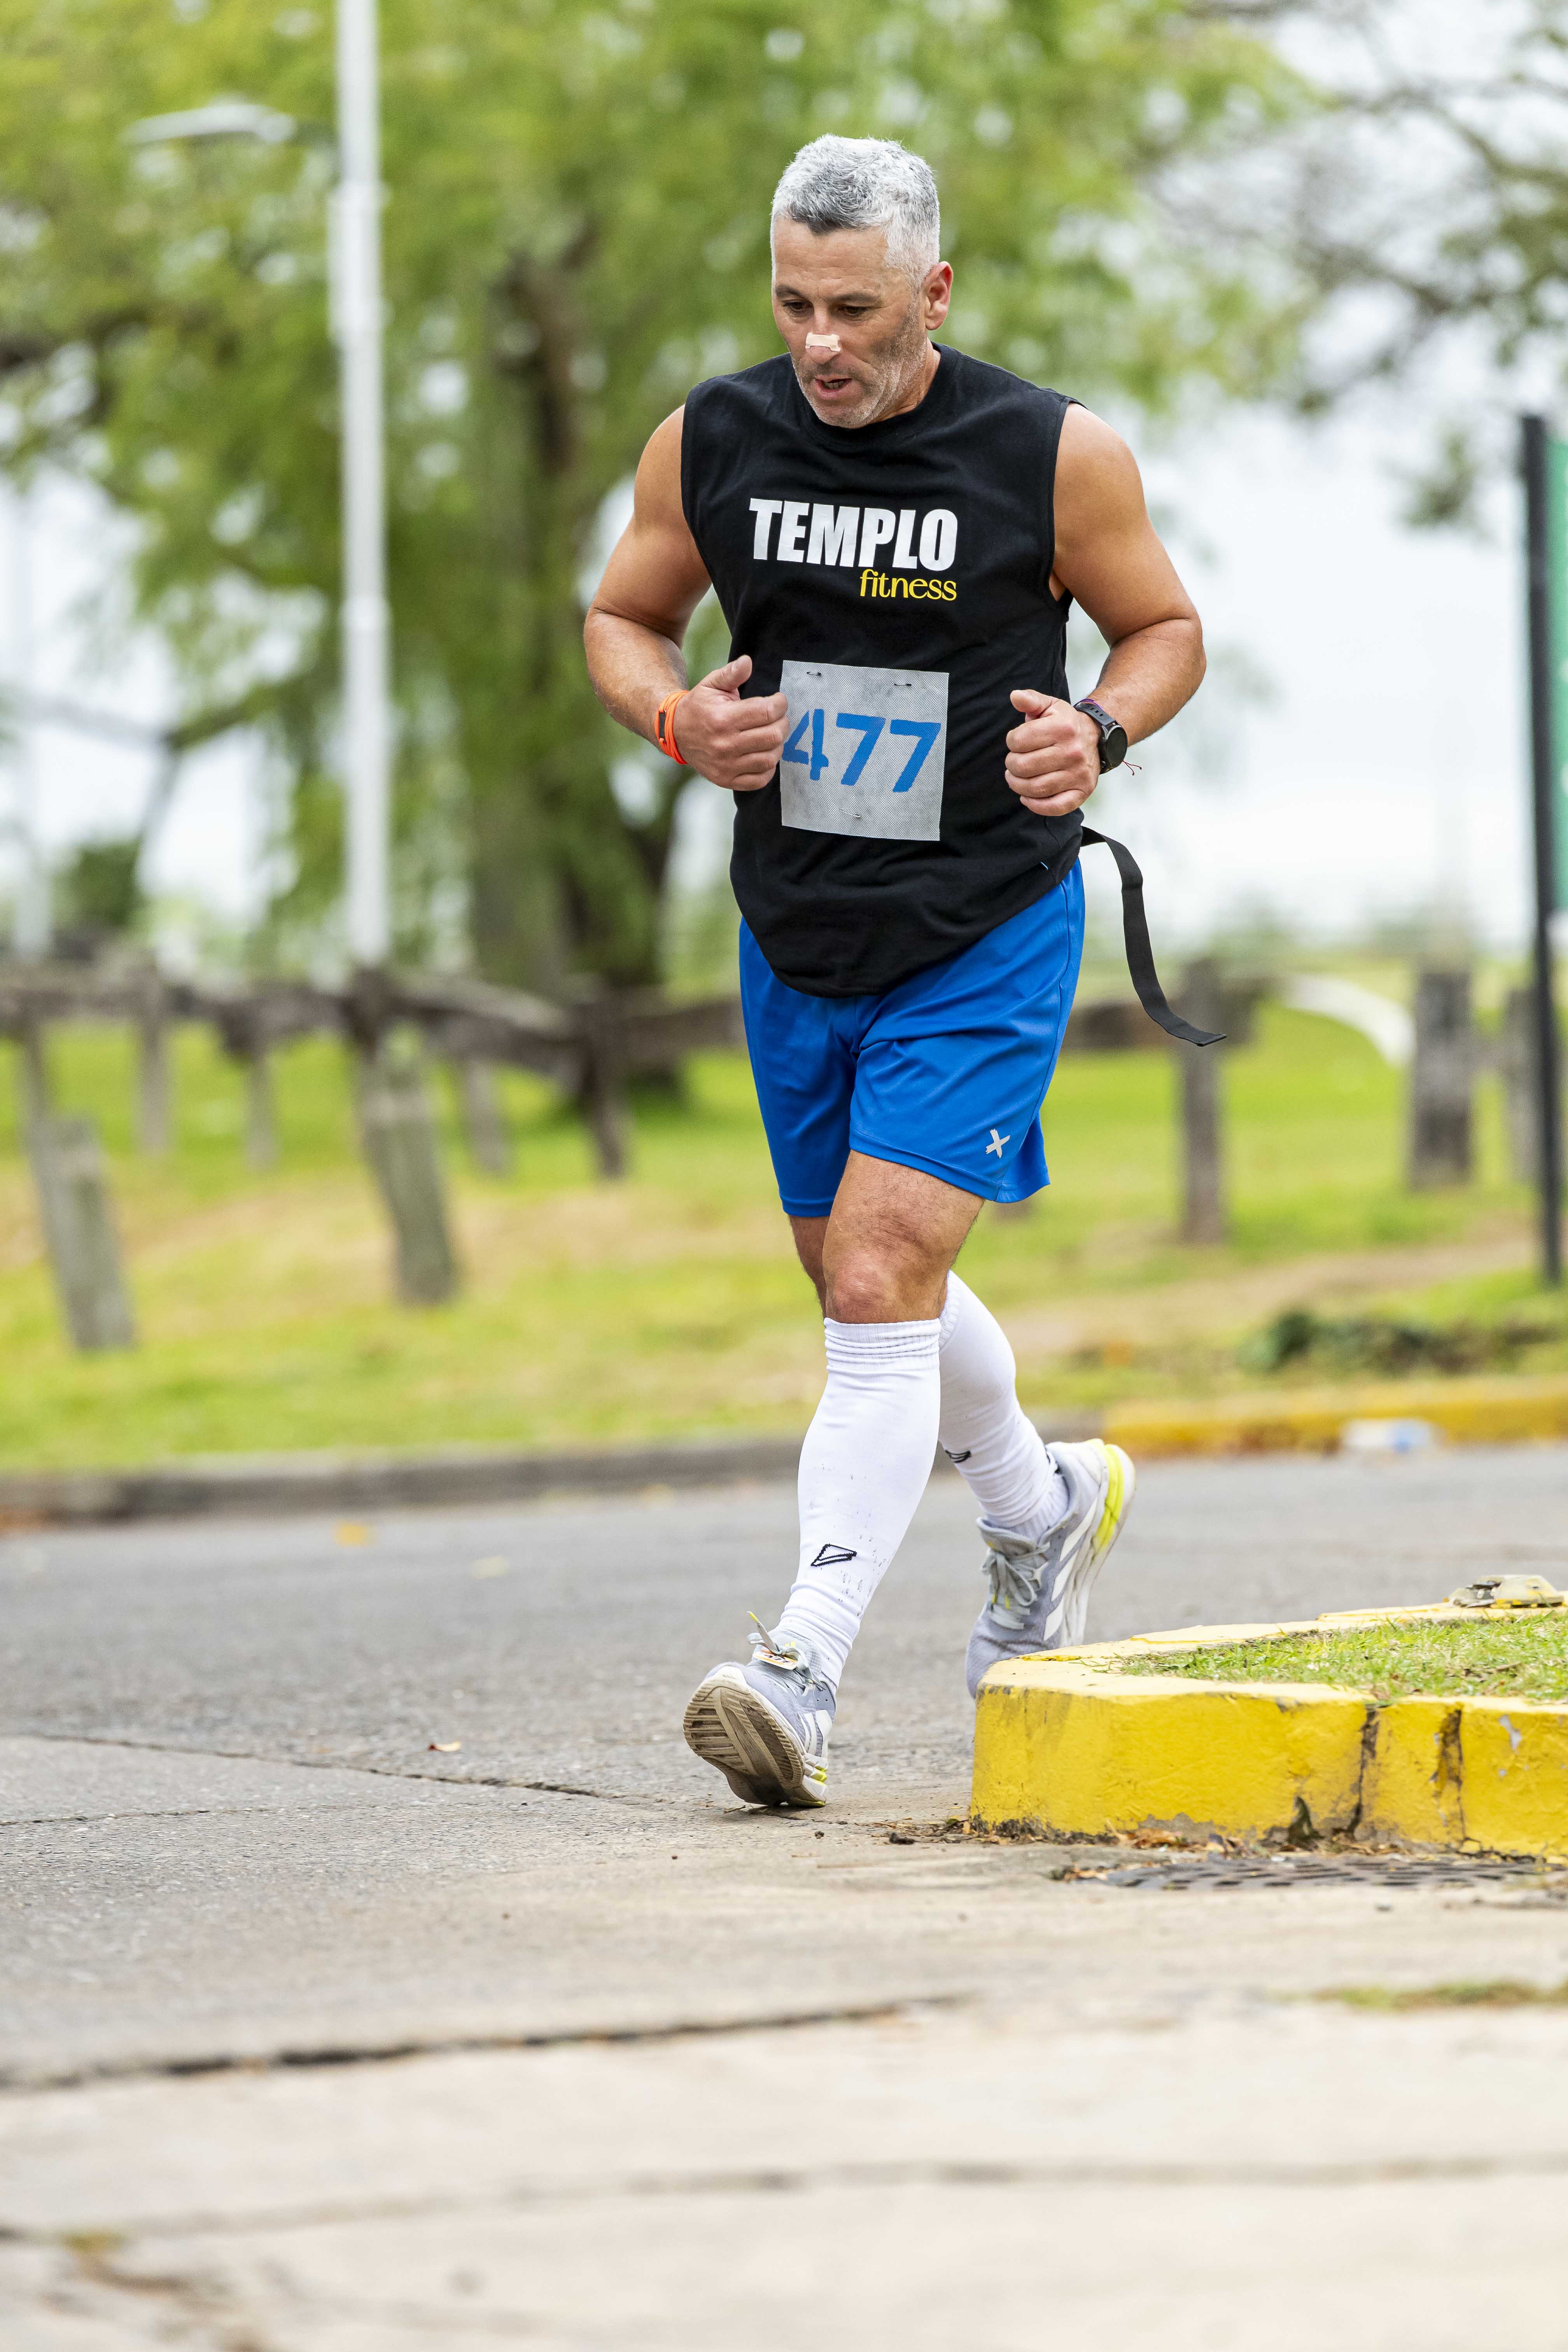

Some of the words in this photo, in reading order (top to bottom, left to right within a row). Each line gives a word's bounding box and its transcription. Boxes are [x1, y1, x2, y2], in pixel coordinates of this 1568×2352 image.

[749, 498, 958, 571] TEMPLO
[860, 569, 957, 601] fitness
[782, 709, 942, 793] 477
